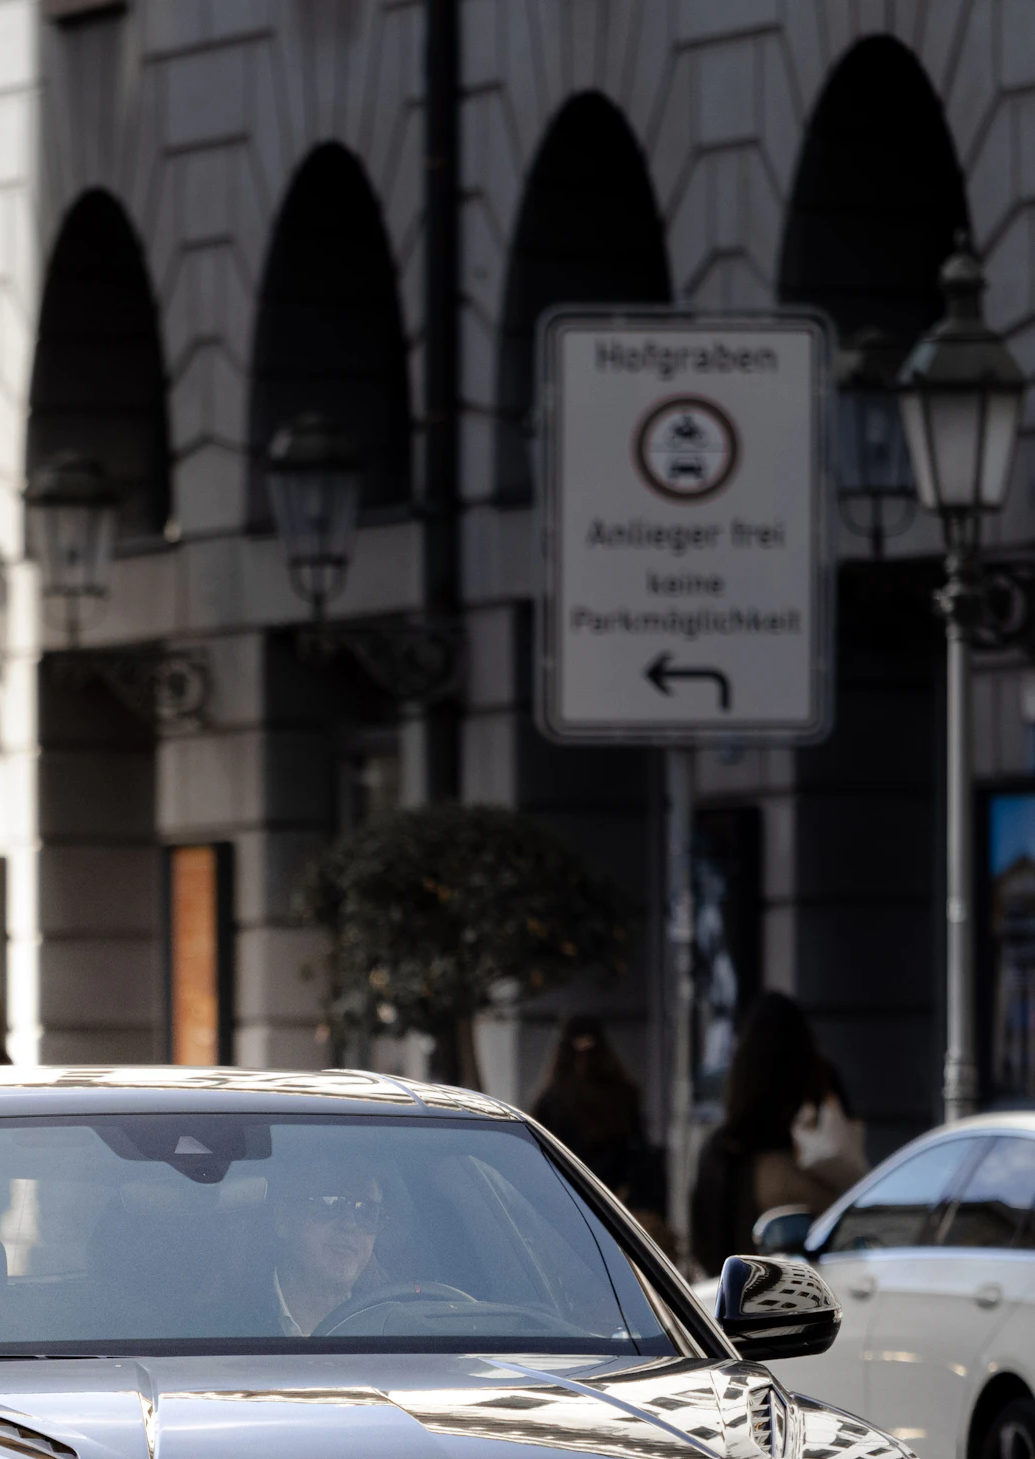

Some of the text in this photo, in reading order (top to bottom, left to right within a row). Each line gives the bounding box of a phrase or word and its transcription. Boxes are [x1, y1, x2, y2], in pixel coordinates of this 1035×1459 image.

[595, 341, 780, 379] Hofgraben
[587, 518, 785, 555] Anlieger frei
[647, 570, 725, 598] keine
[570, 606, 803, 642] Parkmöglichkeit
